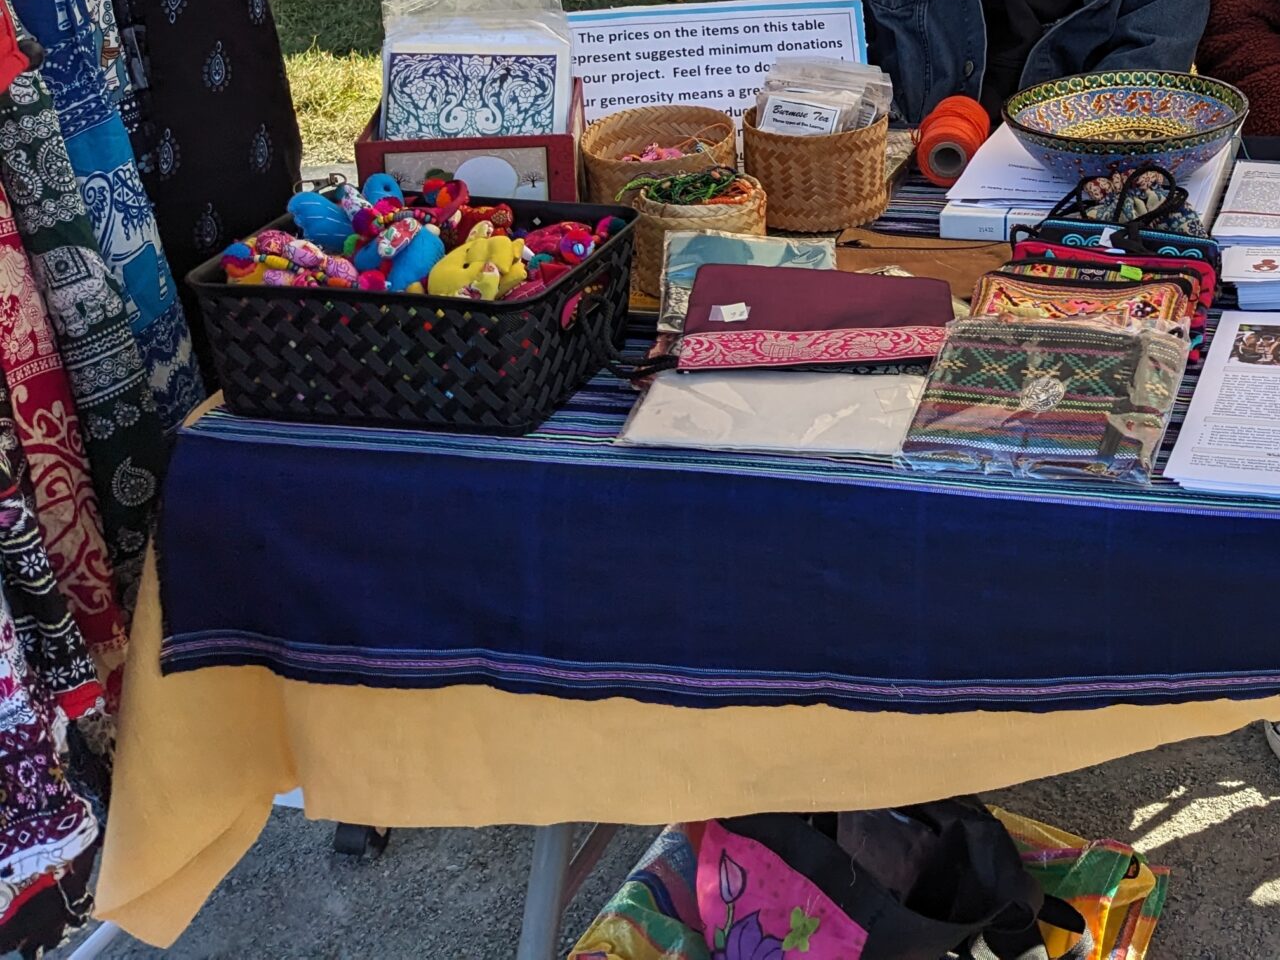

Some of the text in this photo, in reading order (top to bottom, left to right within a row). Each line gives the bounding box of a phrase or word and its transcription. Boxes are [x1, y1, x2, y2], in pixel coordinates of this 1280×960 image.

[578, 19, 825, 45] The prices on the items on this table
[571, 38, 843, 66] epresent suggested minimum donations
[582, 73, 607, 84] our
[611, 68, 665, 88] project.
[672, 66, 701, 79] Feel
[705, 63, 733, 76] free
[736, 63, 751, 75] to
[600, 91, 674, 109] generosity
[678, 90, 722, 102] means
[727, 89, 735, 99] a
[772, 104, 830, 123] Burmese Tea
